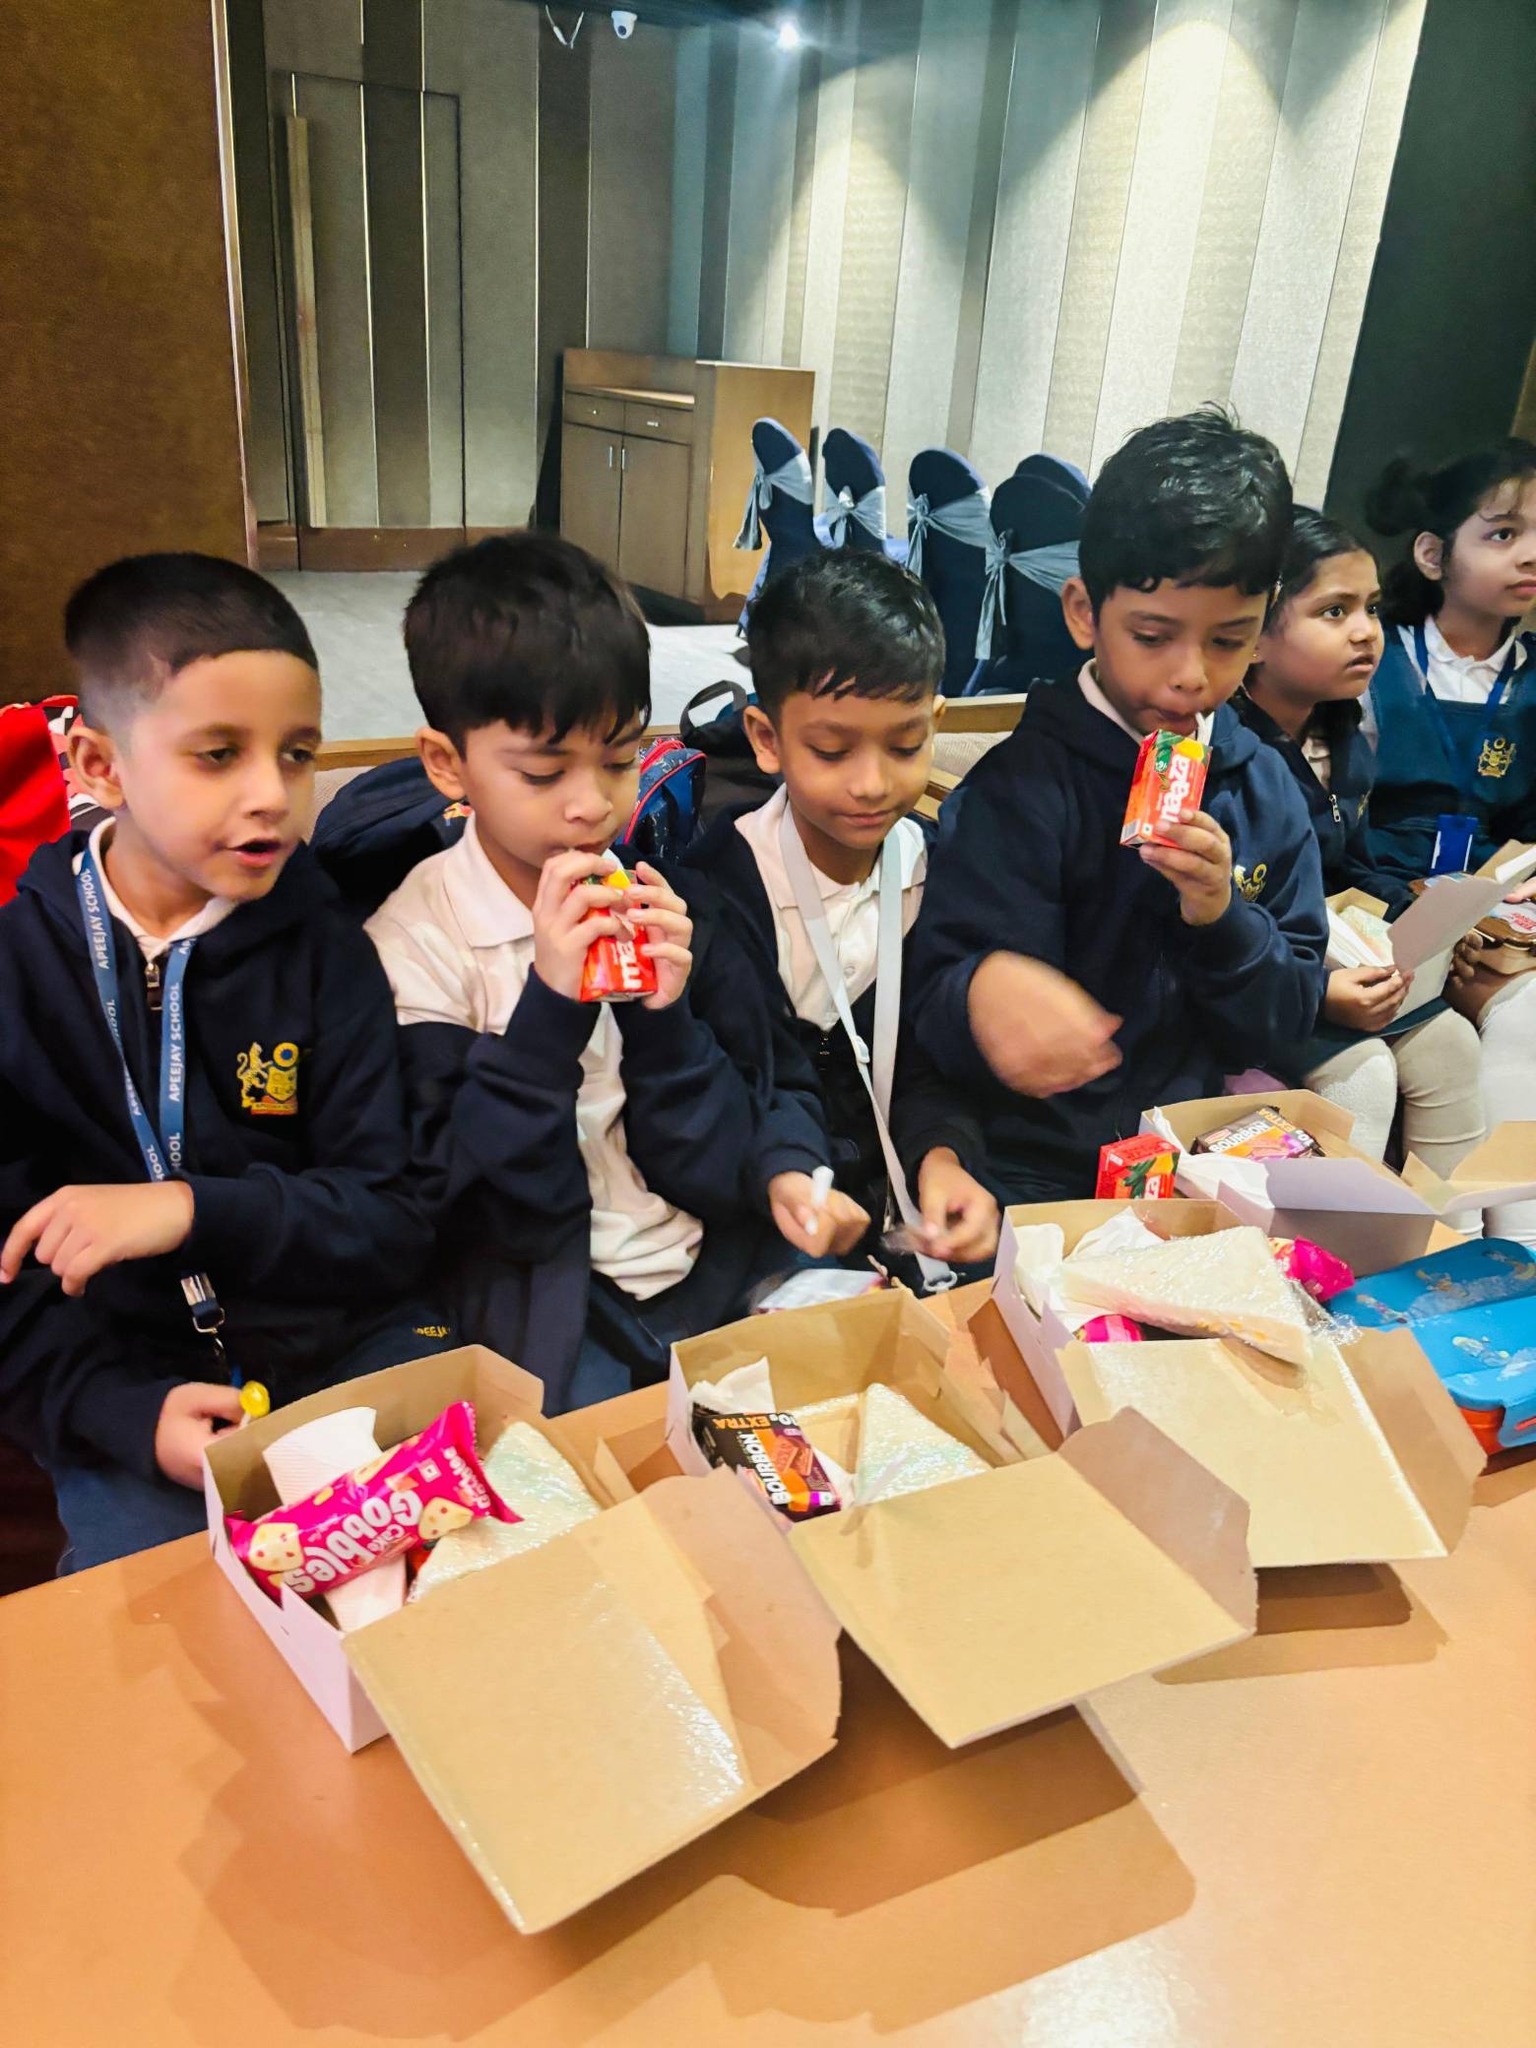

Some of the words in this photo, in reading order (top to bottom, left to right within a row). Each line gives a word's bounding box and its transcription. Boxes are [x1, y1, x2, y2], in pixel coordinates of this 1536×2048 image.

[79, 868, 100, 913] SCHOOL
[89, 915, 110, 970] APEEJAY
[169, 982, 182, 1040] SCHOOL
[168, 1045, 185, 1103] APEEJAY
[1208, 1120, 1271, 1152] BOURBON
[712, 1415, 771, 1430] EXTRA
[740, 1433, 792, 1505] BOURBON
[283, 1489, 423, 1593] Gobbles
